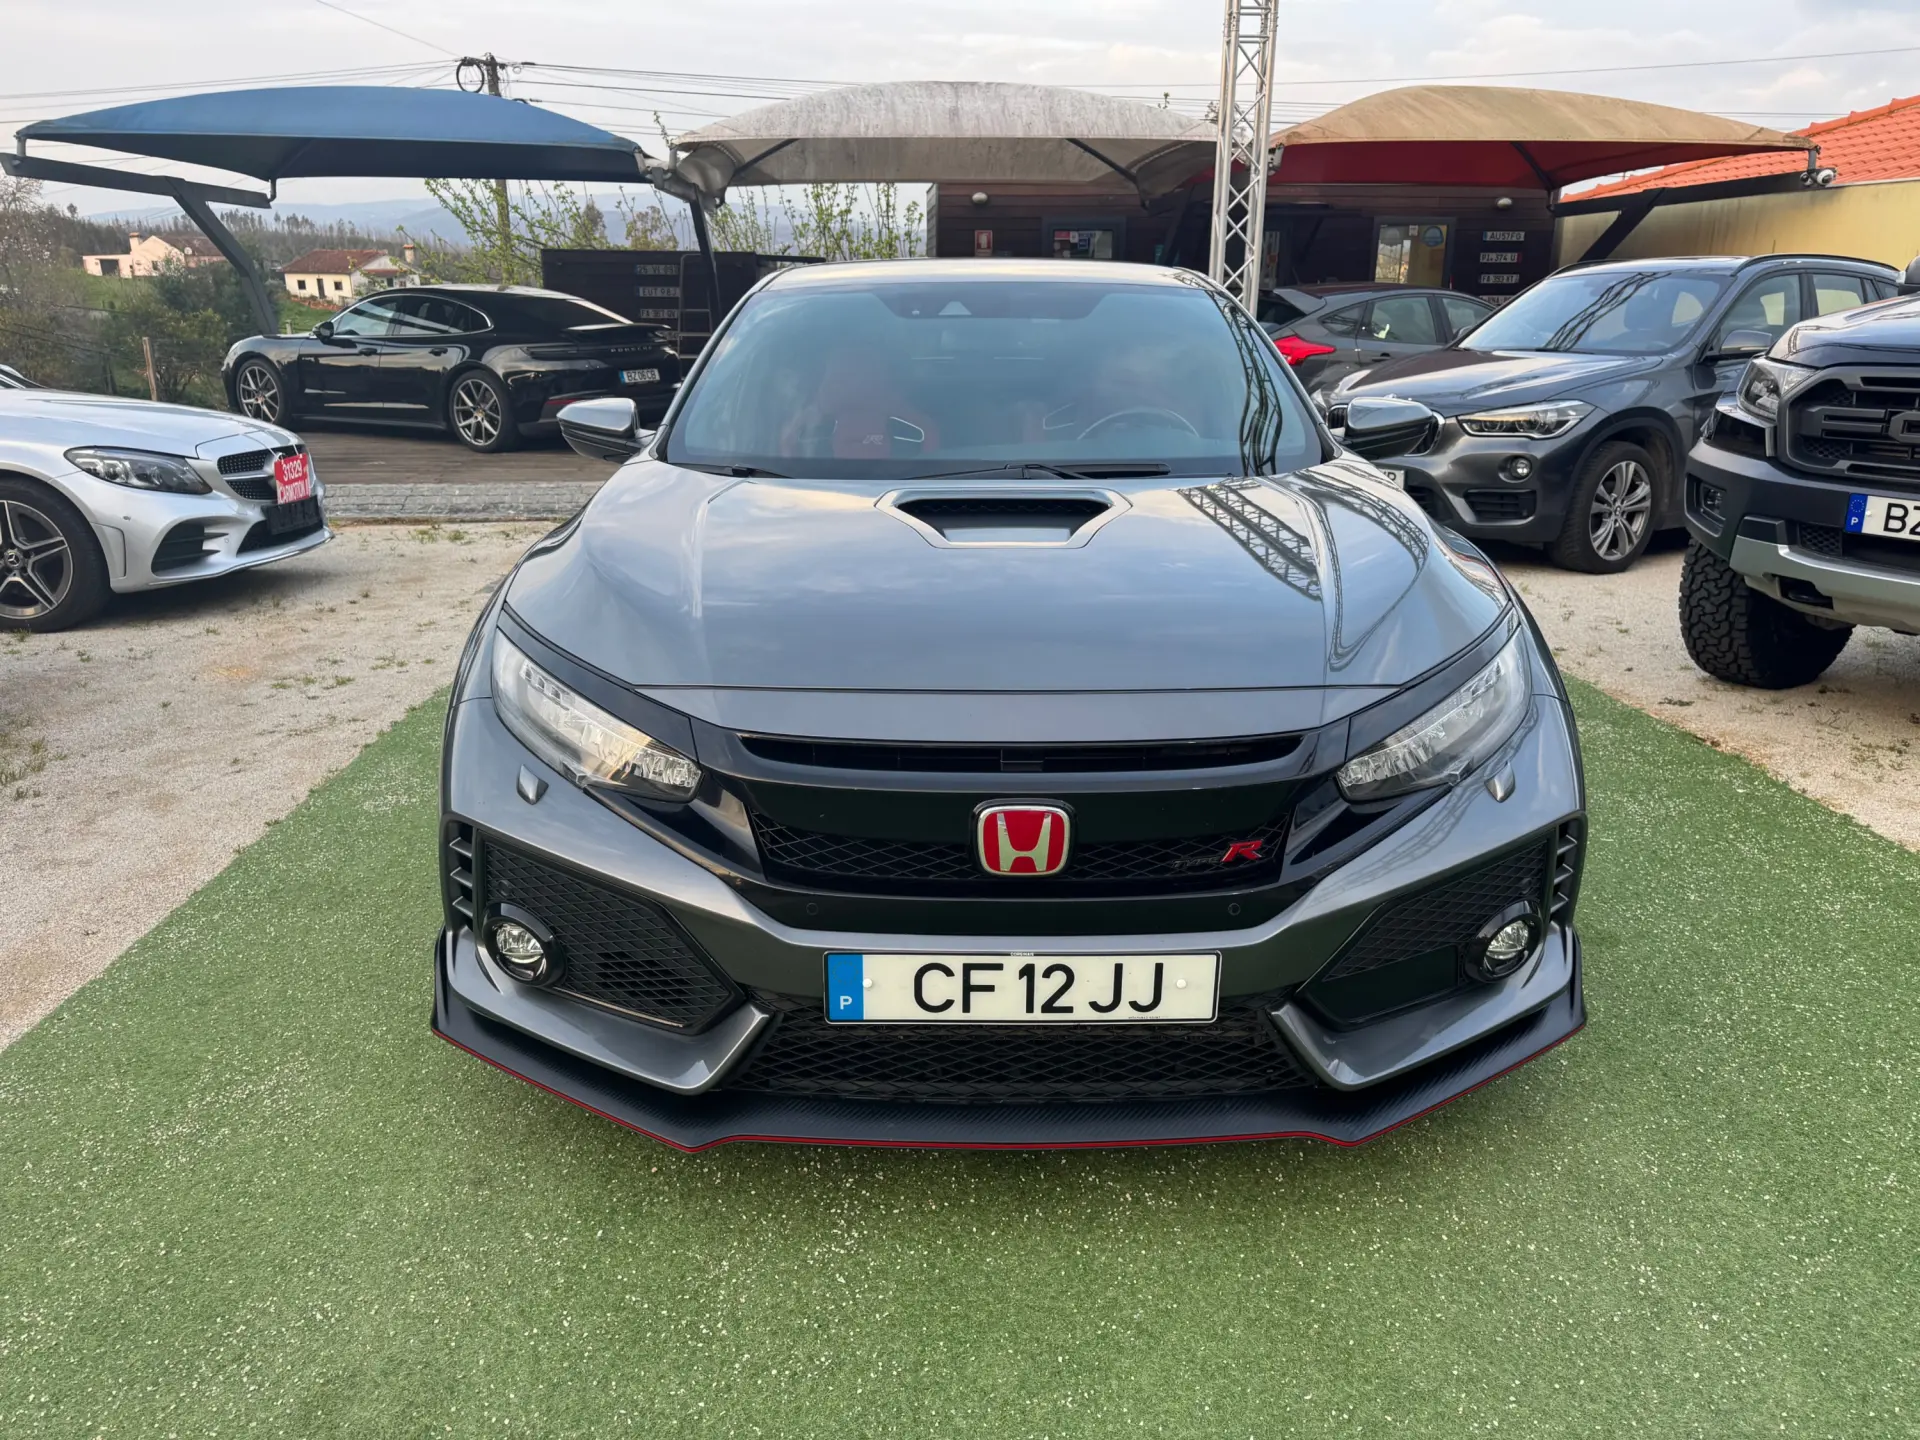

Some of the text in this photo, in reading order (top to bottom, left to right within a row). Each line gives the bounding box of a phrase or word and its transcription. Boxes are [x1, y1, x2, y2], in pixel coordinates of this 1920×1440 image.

[283, 460, 302, 481] 31329
[1850, 517, 1859, 526] P
[1220, 840, 1263, 862] R
[913, 962, 1164, 1014] CF 12 JJ
[839, 995, 853, 1010] P
